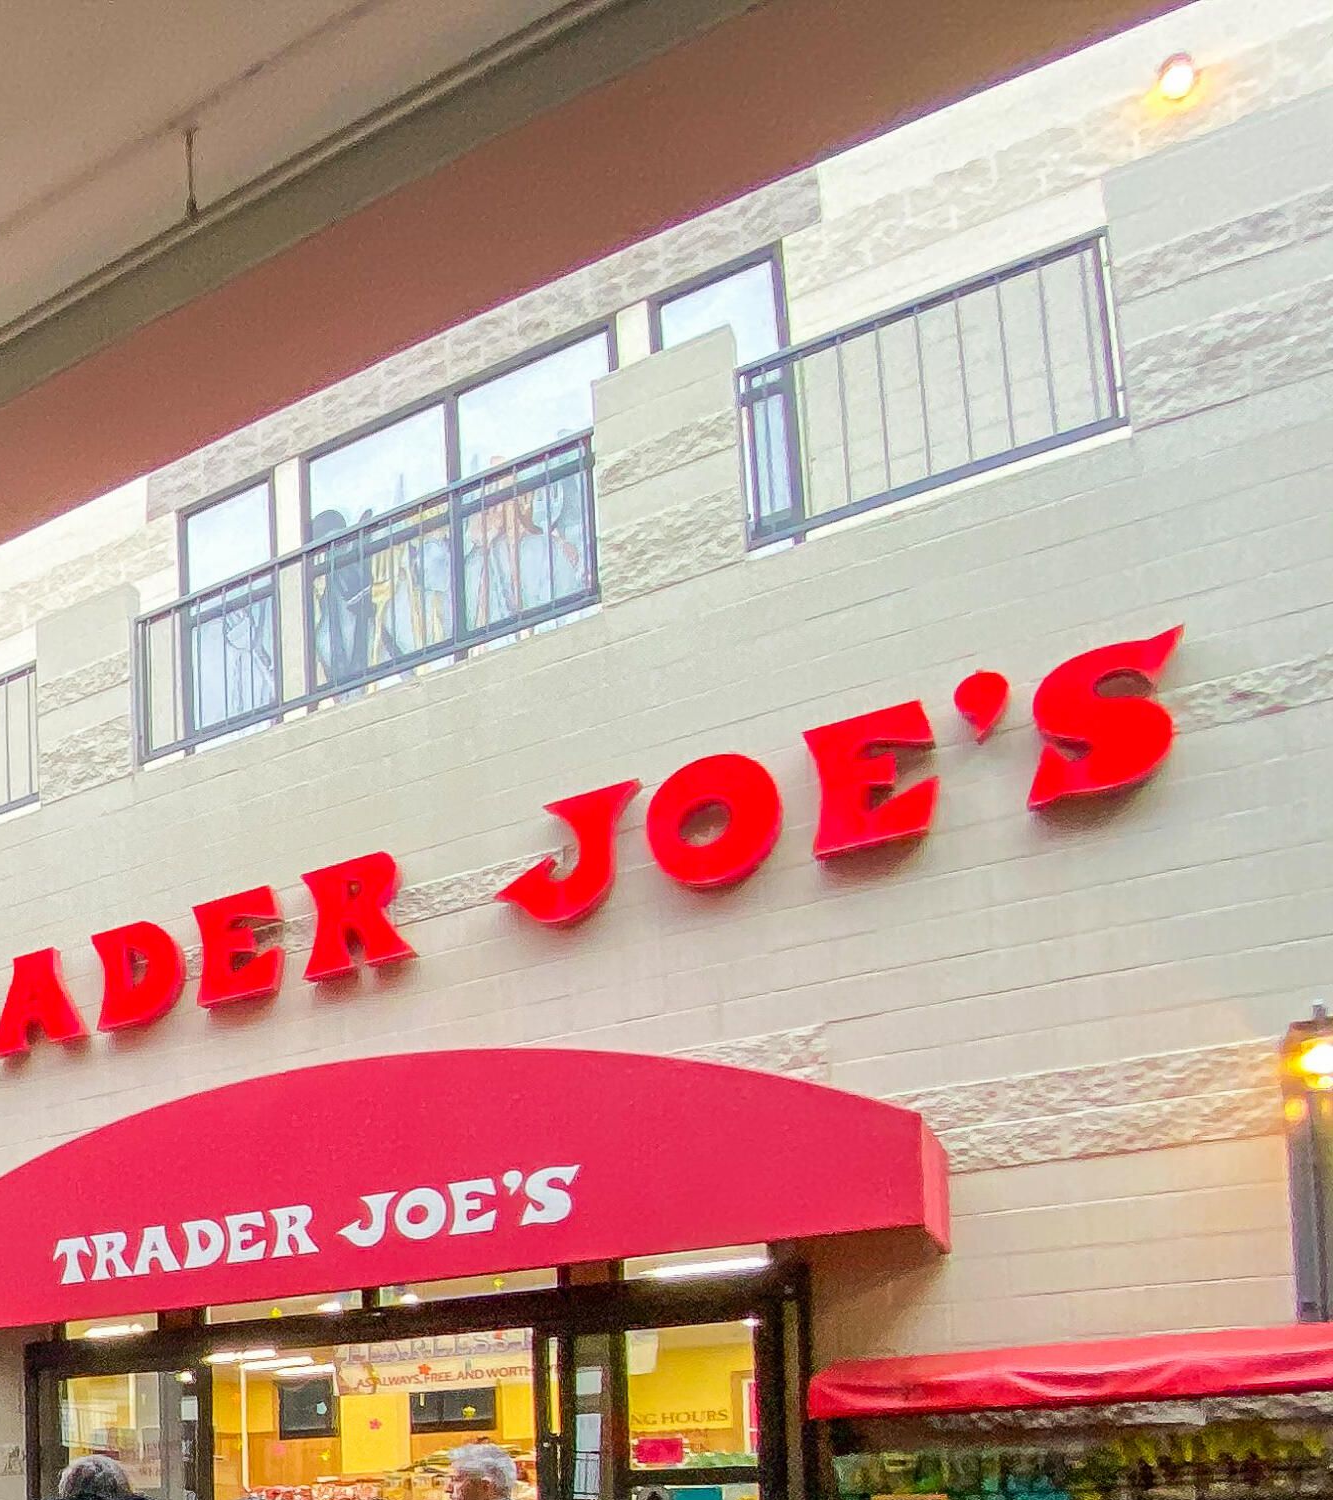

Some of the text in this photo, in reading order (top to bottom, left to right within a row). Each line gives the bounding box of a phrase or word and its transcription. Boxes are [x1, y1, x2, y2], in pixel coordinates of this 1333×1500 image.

[495, 626, 1184, 926] JOE'S
[52, 1163, 581, 1286] TRADER JOE'S
[457, 1368, 484, 1381] AND
[661, 1408, 728, 1425] HOURS
